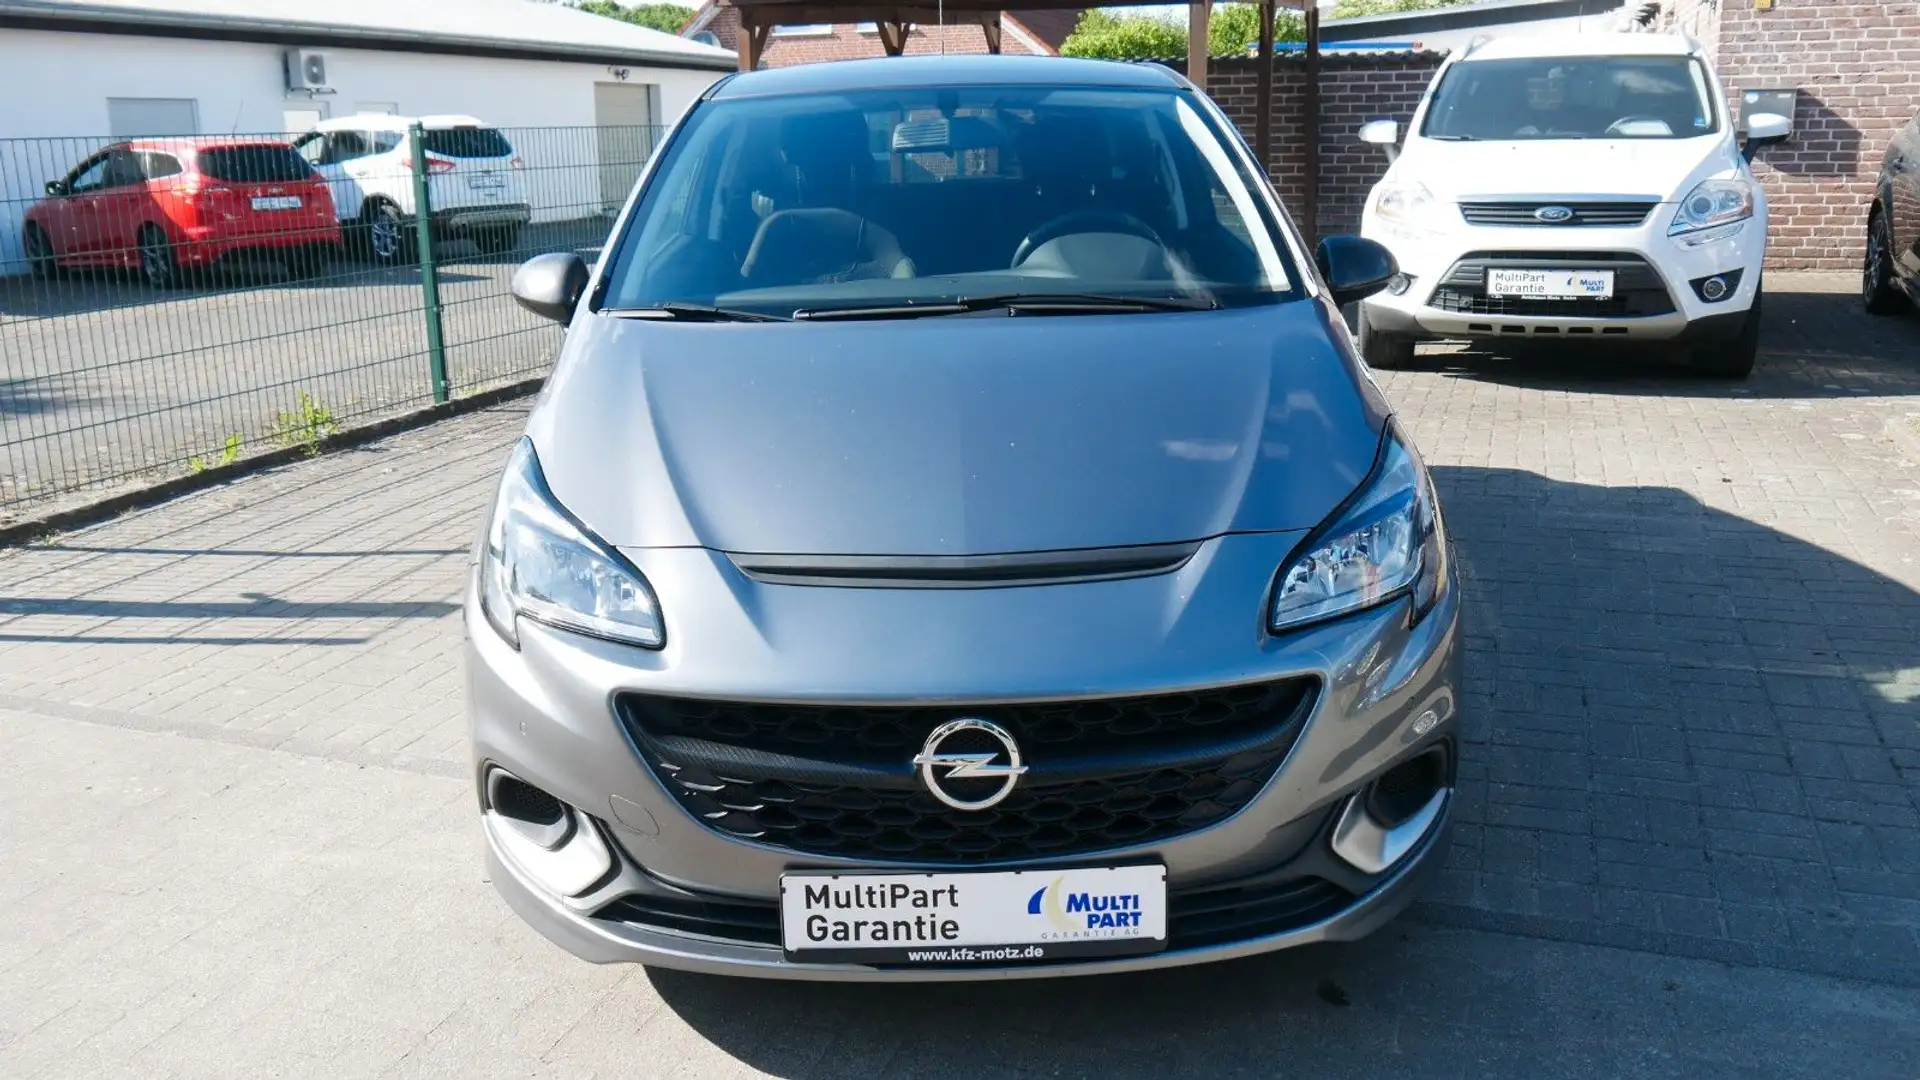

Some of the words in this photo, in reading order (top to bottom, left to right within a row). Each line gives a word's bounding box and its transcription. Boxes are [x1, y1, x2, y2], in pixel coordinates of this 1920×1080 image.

[1495, 272, 1545, 282] MultiPart
[1495, 283, 1545, 293] Garantie
[804, 883, 959, 910] MultiPart
[1065, 892, 1140, 913] MULTI
[806, 913, 960, 942] Garantie
[1086, 911, 1142, 929] PART
[1041, 929, 1116, 940] GARANTIE
[1124, 928, 1140, 936] AG
[908, 946, 1044, 962] www.kfz-motz.de
